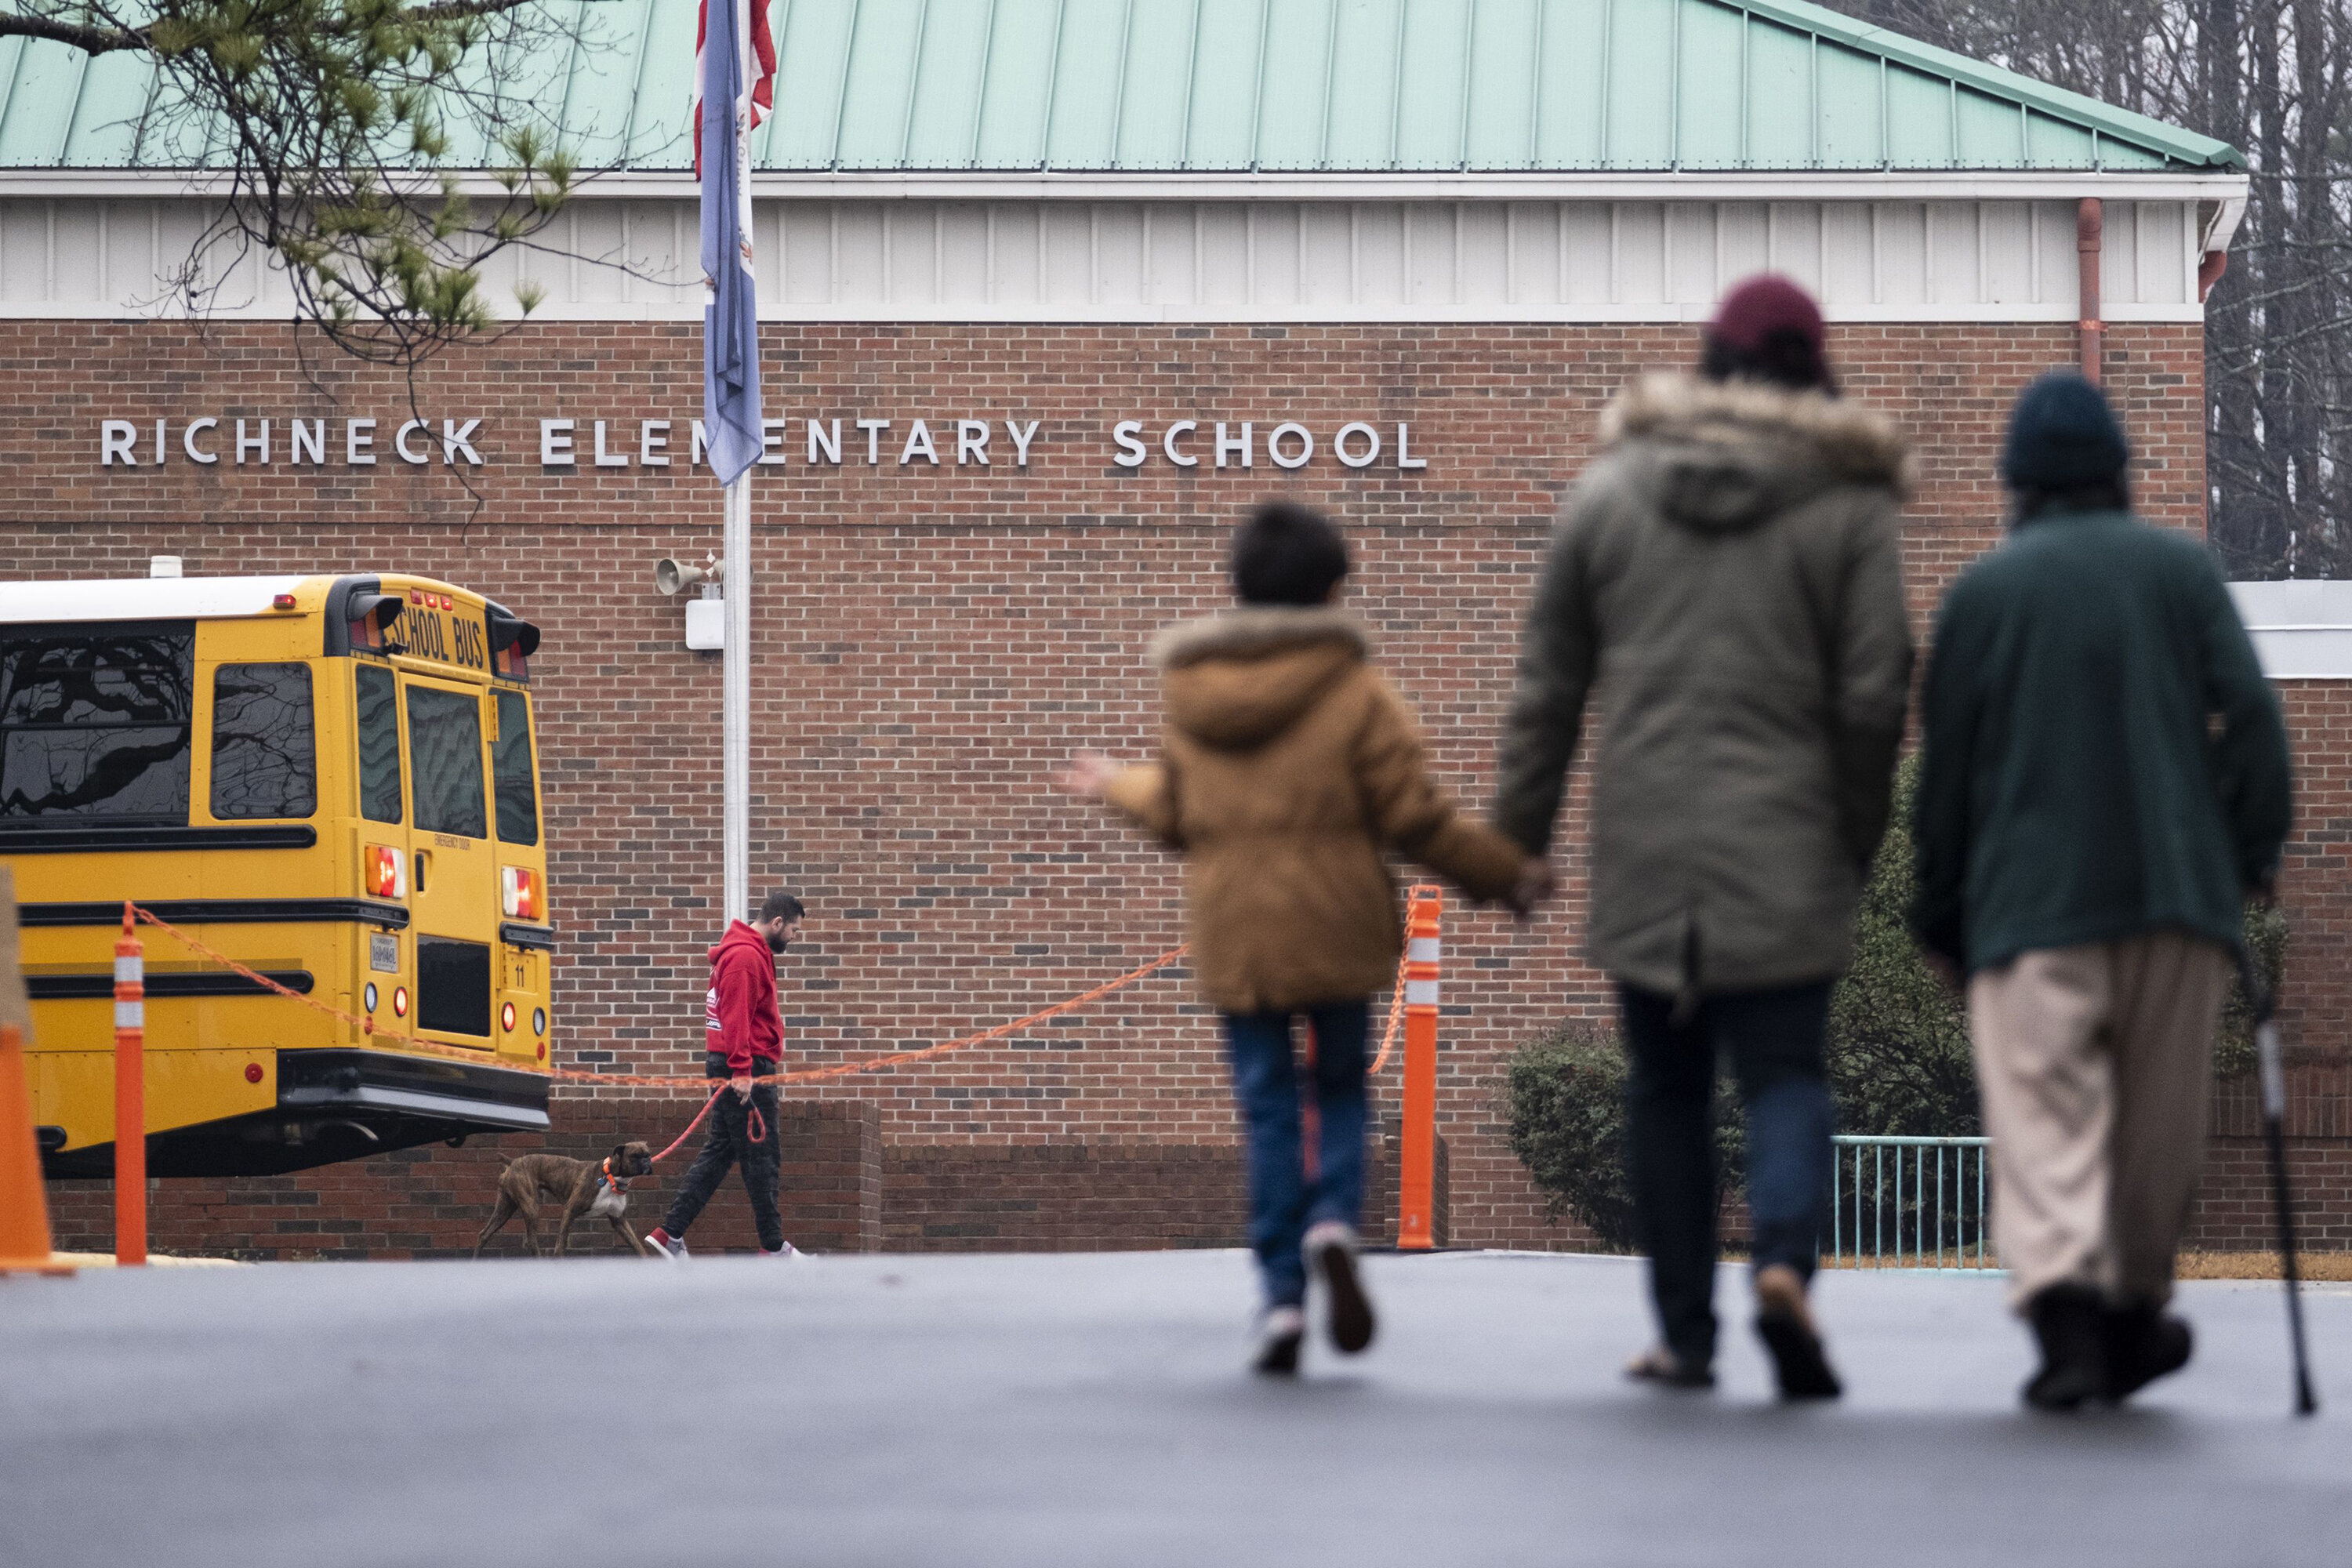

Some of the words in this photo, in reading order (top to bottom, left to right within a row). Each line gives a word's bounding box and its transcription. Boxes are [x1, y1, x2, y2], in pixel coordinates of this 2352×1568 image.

[101, 417, 485, 466] RICHNECK
[1112, 419, 1428, 468] SCHOOL
[452, 615, 484, 670] BUS
[434, 833, 459, 849] EMERGENCY
[459, 837, 471, 851] DOOR
[514, 964, 524, 988] 11
